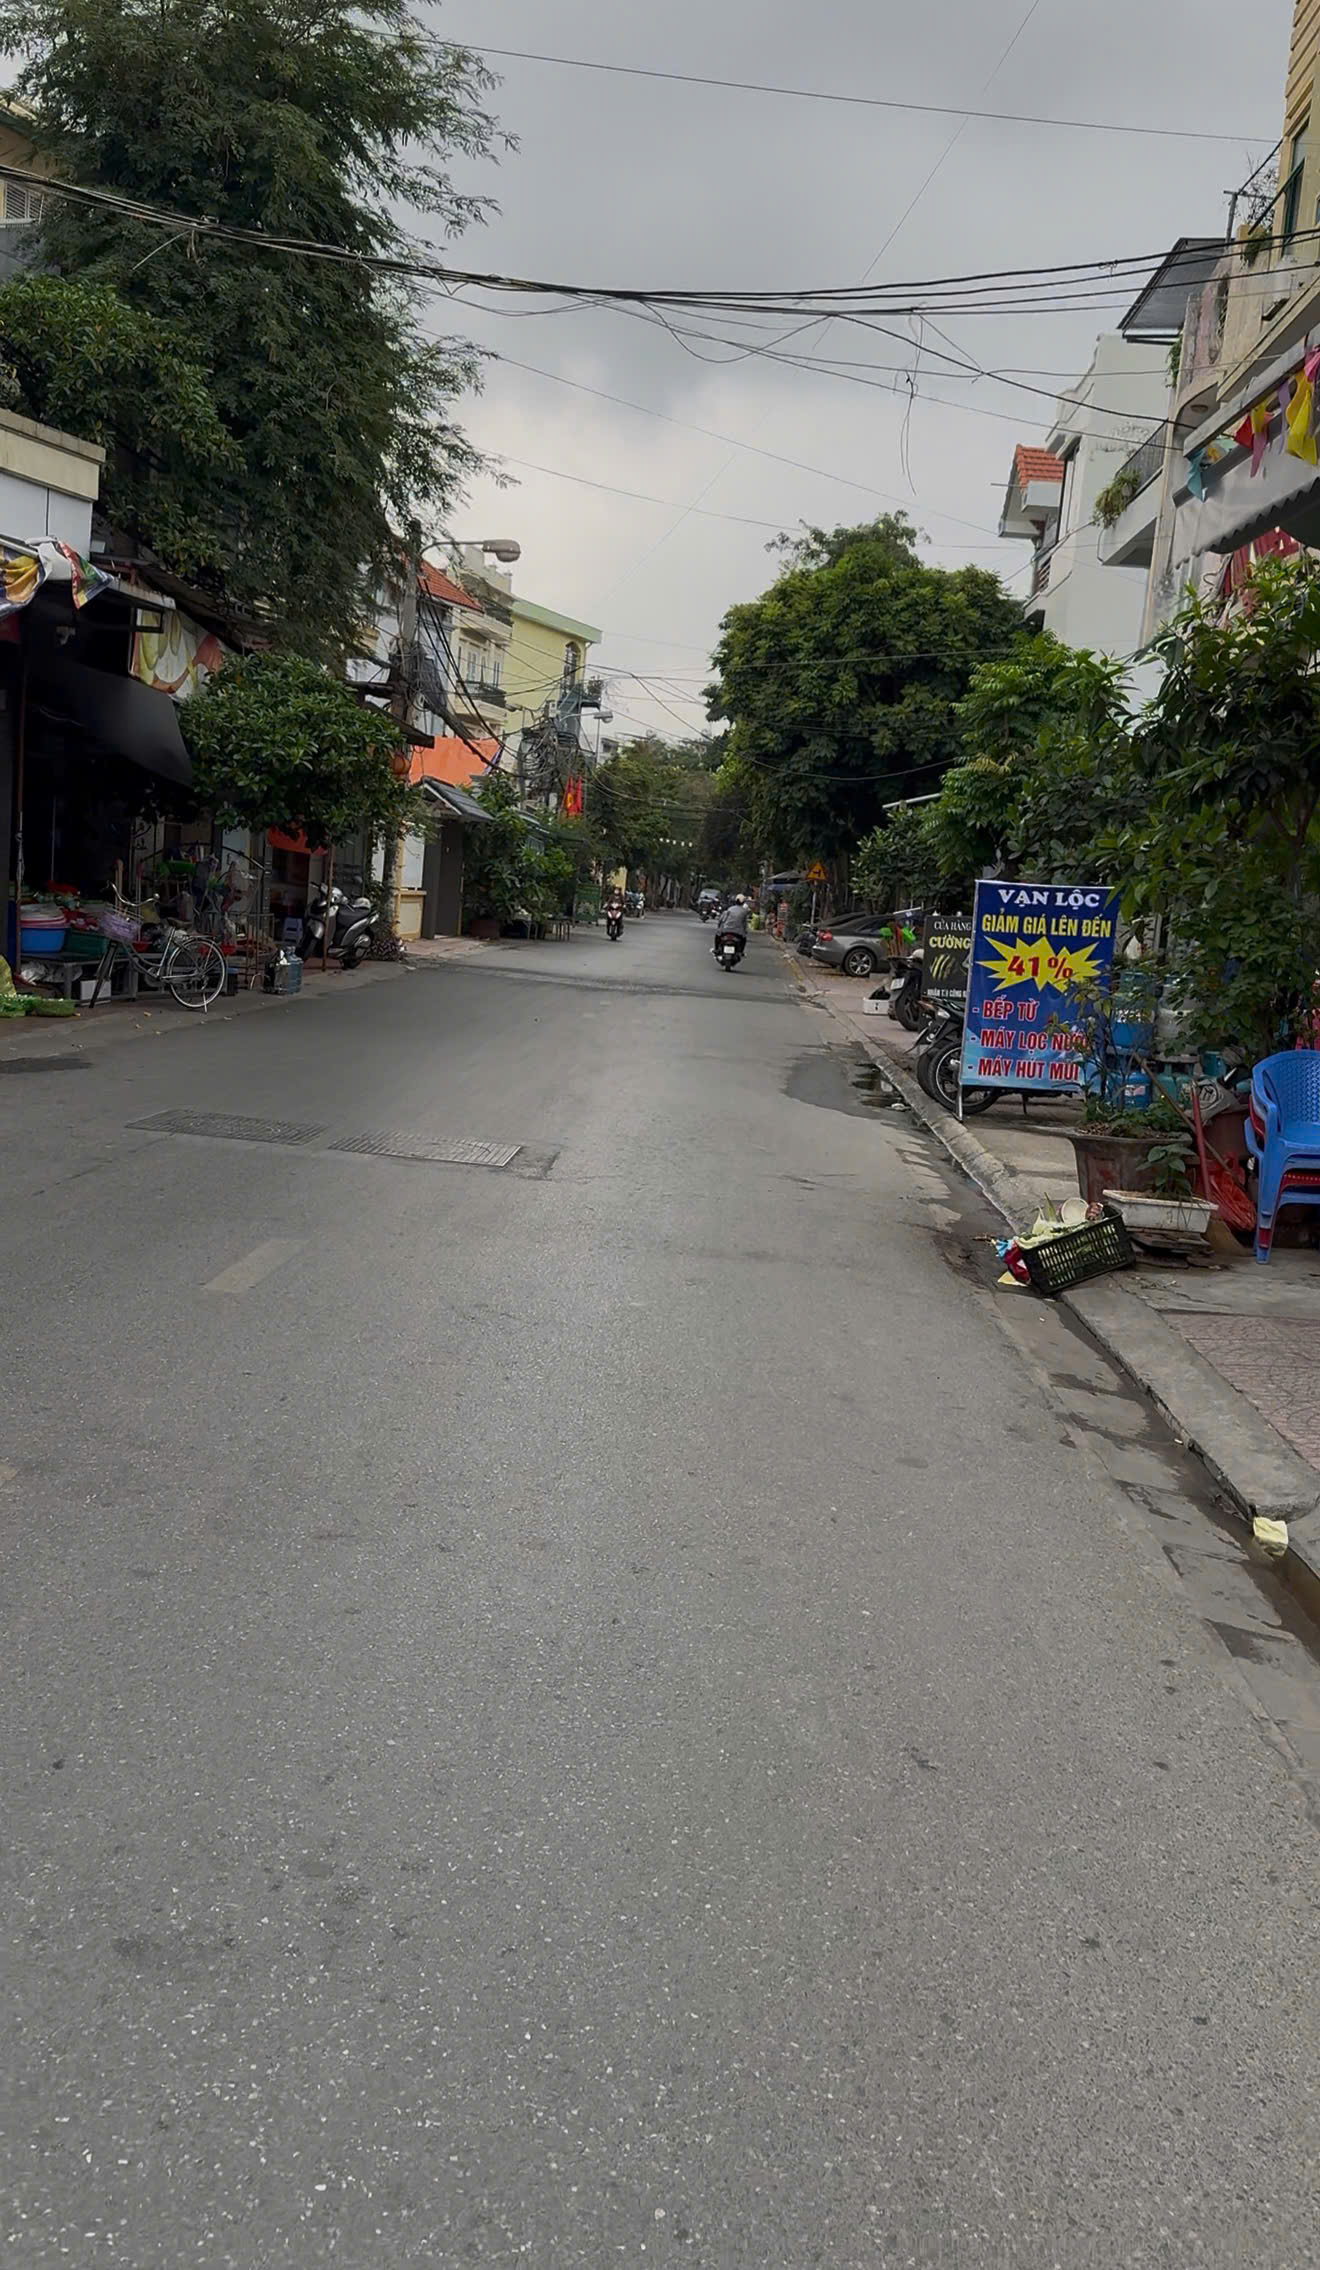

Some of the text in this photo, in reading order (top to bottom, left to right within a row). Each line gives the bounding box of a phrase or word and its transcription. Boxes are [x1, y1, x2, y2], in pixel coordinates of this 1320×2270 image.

[998, 889, 1100, 910] VẠN LỘC
[982, 907, 1111, 937] GIẢM GIÁ LÊN ĐẾN
[929, 934, 971, 949] CƯỜNG
[983, 994, 1040, 1022] BẾP TỪ
[980, 1025, 1016, 1049] MÁY
[1018, 1031, 1047, 1055] LỌC
[978, 1055, 1011, 1078] MÁY
[1015, 1057, 1045, 1079] HÚT
